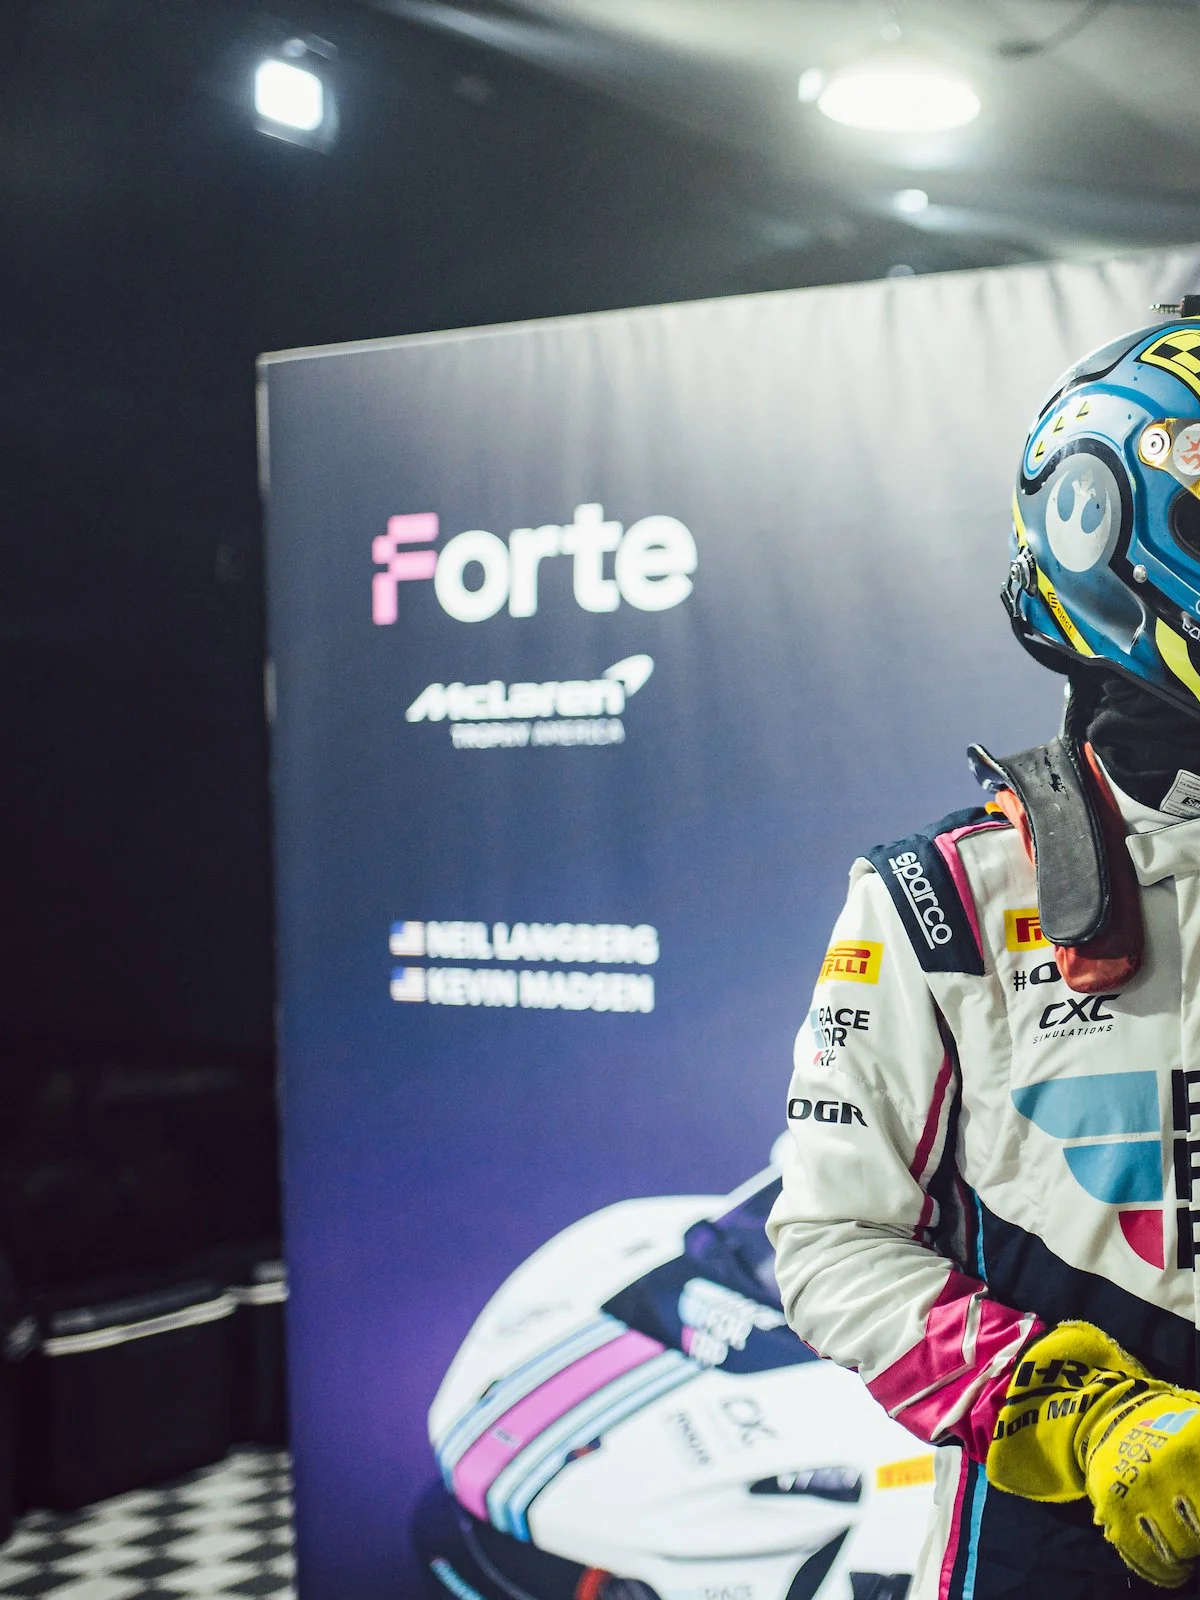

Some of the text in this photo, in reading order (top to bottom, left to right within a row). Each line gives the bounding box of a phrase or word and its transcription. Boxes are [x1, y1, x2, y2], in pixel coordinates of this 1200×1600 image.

[372, 503, 698, 625] Forte
[891, 851, 953, 947] sparco
[427, 920, 494, 960] NEIL
[427, 967, 655, 1013] KEVIN MADSEN
[819, 1005, 870, 1031] RACE
[1039, 993, 1121, 1029] CXC
[1032, 1024, 1114, 1044] SIMULATIONS
[788, 1098, 869, 1128] OGR
[992, 1408, 1039, 1440] Jon
[1109, 1436, 1168, 1499] RACE
